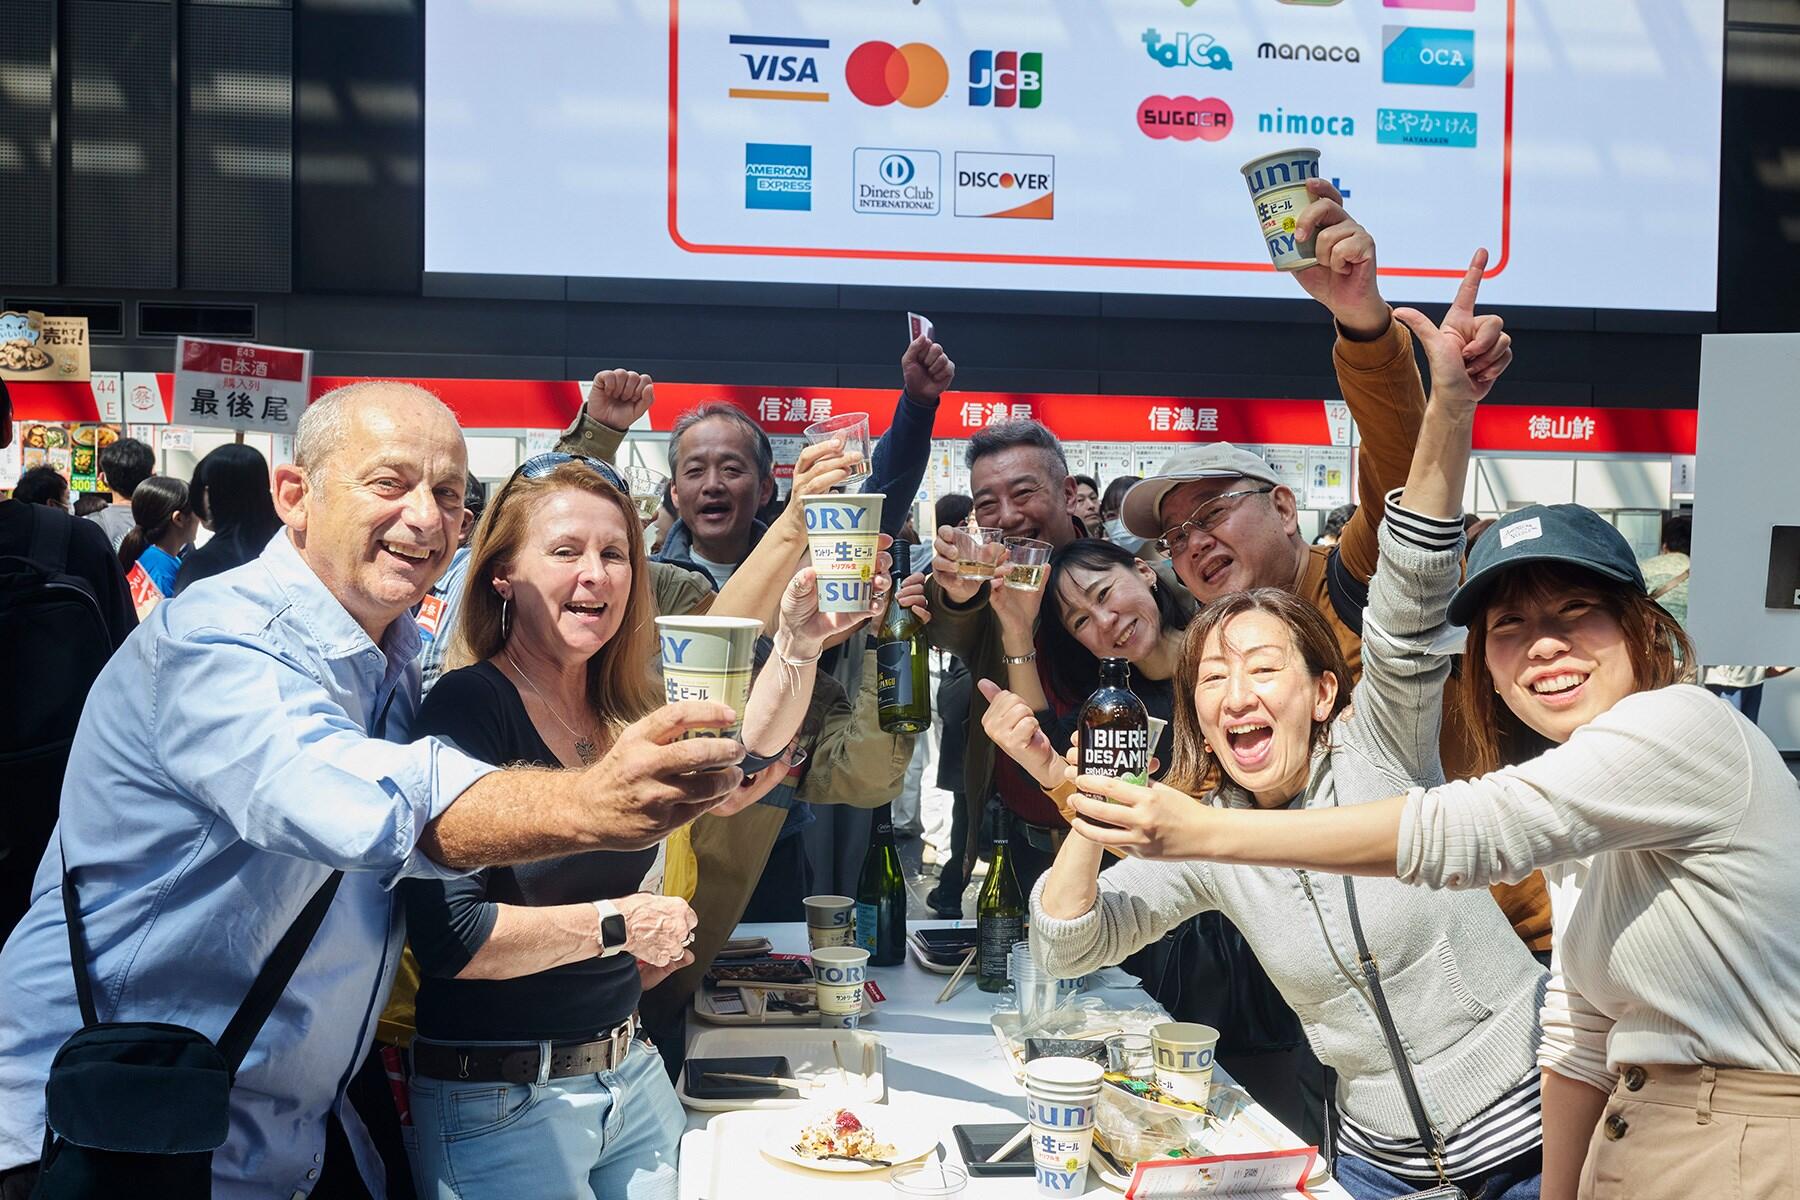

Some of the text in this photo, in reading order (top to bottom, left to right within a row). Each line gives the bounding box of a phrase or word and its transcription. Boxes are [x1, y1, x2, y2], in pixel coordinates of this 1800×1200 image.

[1257, 41, 1361, 64] manaca
[740, 53, 819, 83] VISA
[1258, 107, 1354, 137] nimoca
[745, 165, 807, 178] AMERICAN
[958, 171, 1048, 190] DISCOVER
[759, 179, 812, 191] EXPRESS
[859, 184, 934, 201] Diners Club
[859, 200, 934, 210] INTERNATIONAL
[236, 347, 256, 358] E43
[220, 358, 269, 377] 日本酒
[97, 380, 116, 394] 44
[106, 402, 116, 415] E
[190, 388, 289, 422] 最後尾
[758, 396, 832, 422] 信濃屋
[1330, 407, 1347, 421] 42
[1148, 405, 1219, 432] 信濃屋
[1337, 427, 1345, 440] E
[804, 507, 867, 530] ORY
[1094, 728, 1148, 749] BIERE
[1085, 748, 1114, 764] DES
